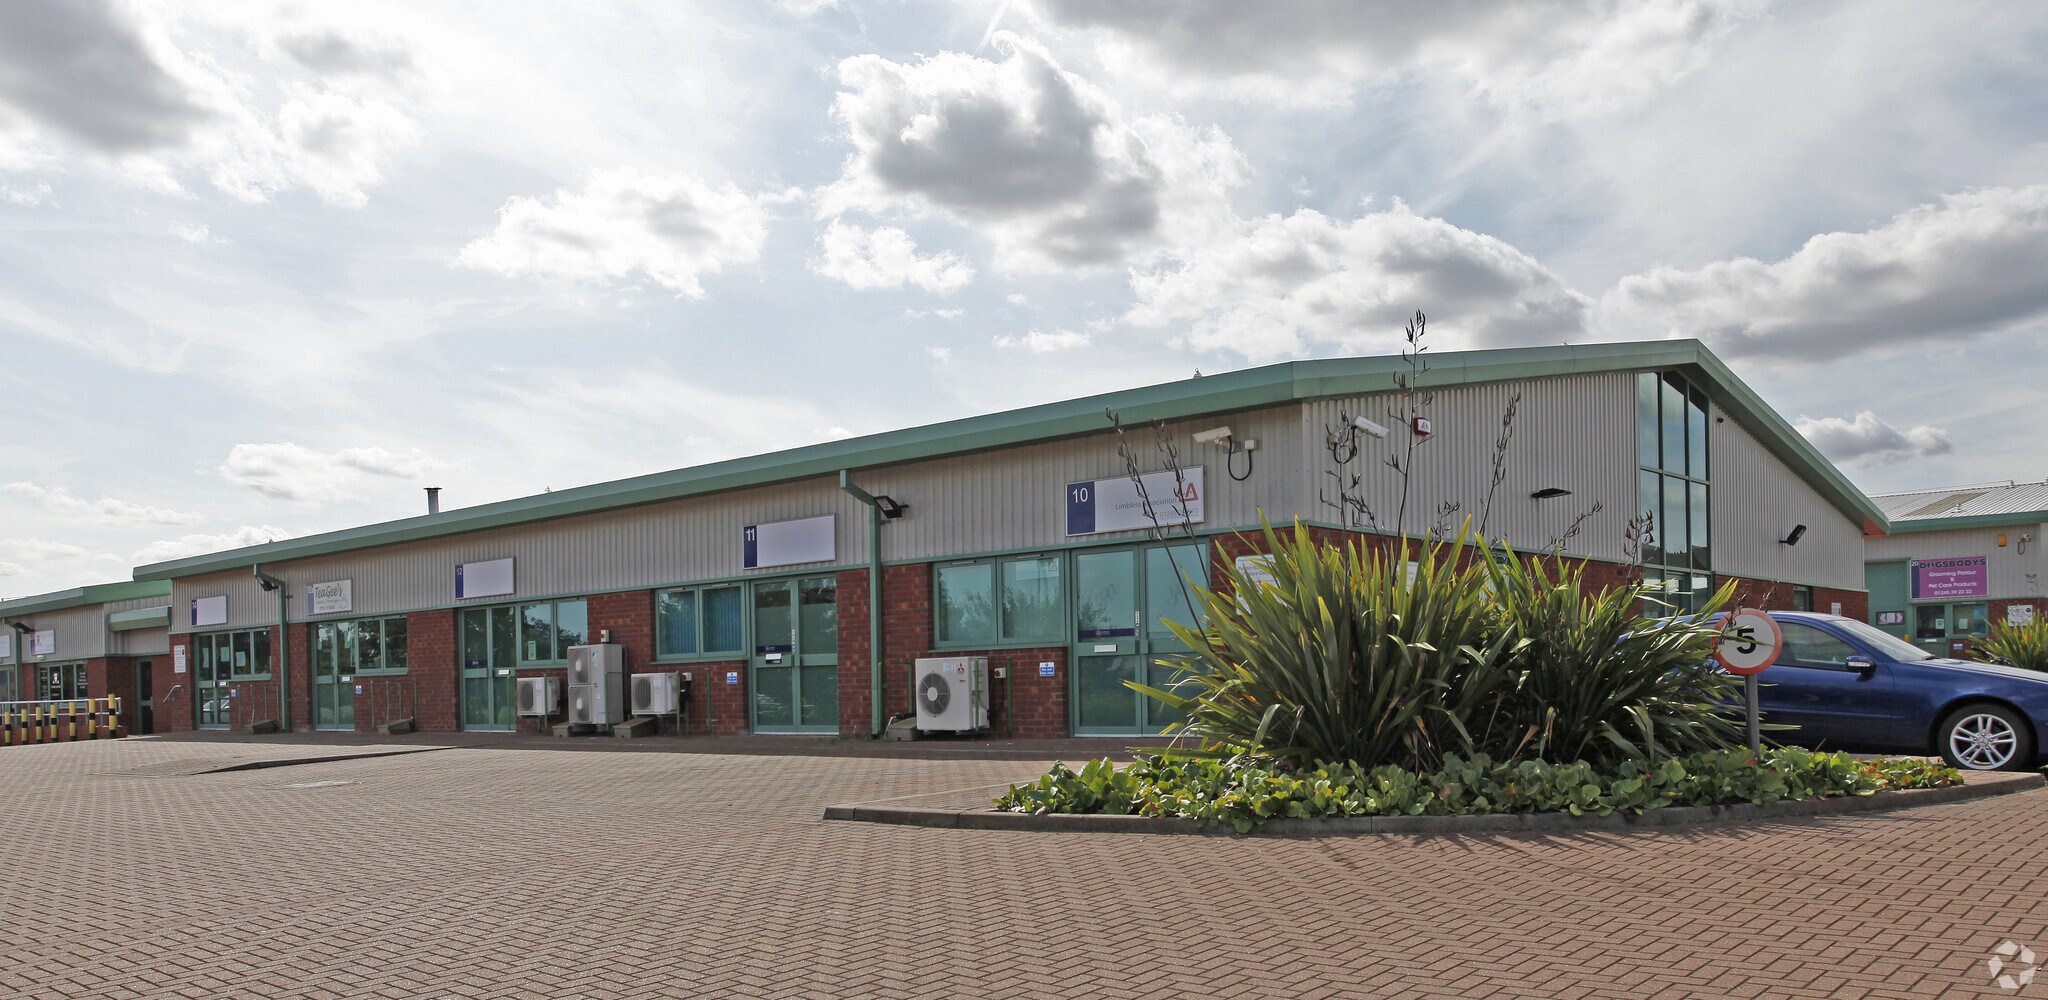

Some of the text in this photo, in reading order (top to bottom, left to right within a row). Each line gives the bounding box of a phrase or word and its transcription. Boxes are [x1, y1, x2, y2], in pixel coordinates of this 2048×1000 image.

[1072, 487, 1088, 503] 10
[1116, 497, 1177, 510] Limbless sociation
[746, 528, 755, 541] 11
[1920, 559, 1986, 568] DOGSBODYS
[457, 567, 463, 575] 12
[315, 583, 343, 599] TeaGee's
[1737, 628, 1757, 654] 5
